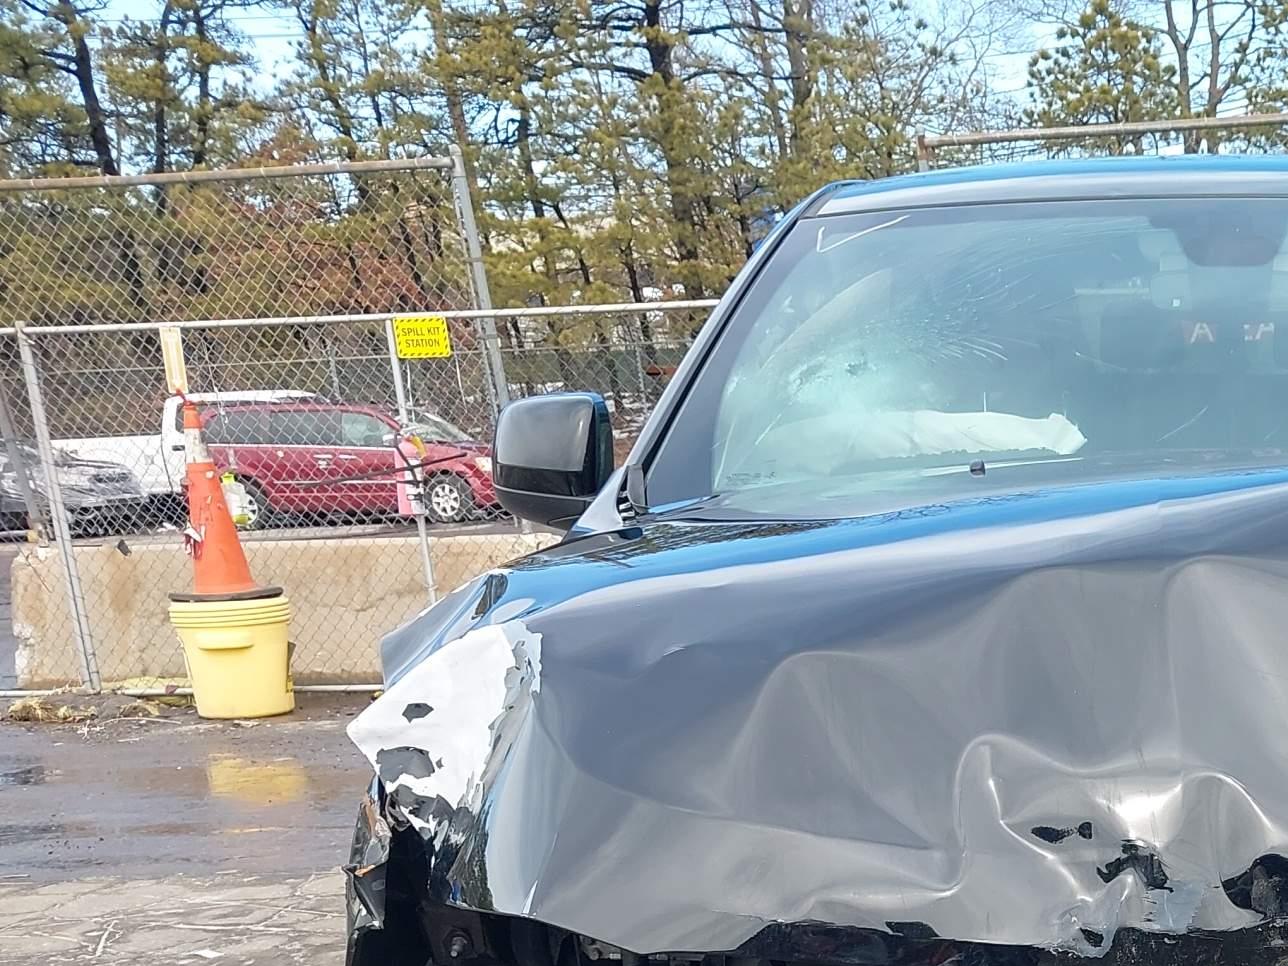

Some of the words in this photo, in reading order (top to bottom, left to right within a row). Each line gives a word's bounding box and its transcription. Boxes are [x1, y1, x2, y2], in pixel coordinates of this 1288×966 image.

[401, 327, 425, 336] SPILL
[427, 326, 440, 336] KIT
[405, 338, 440, 348] STATION
